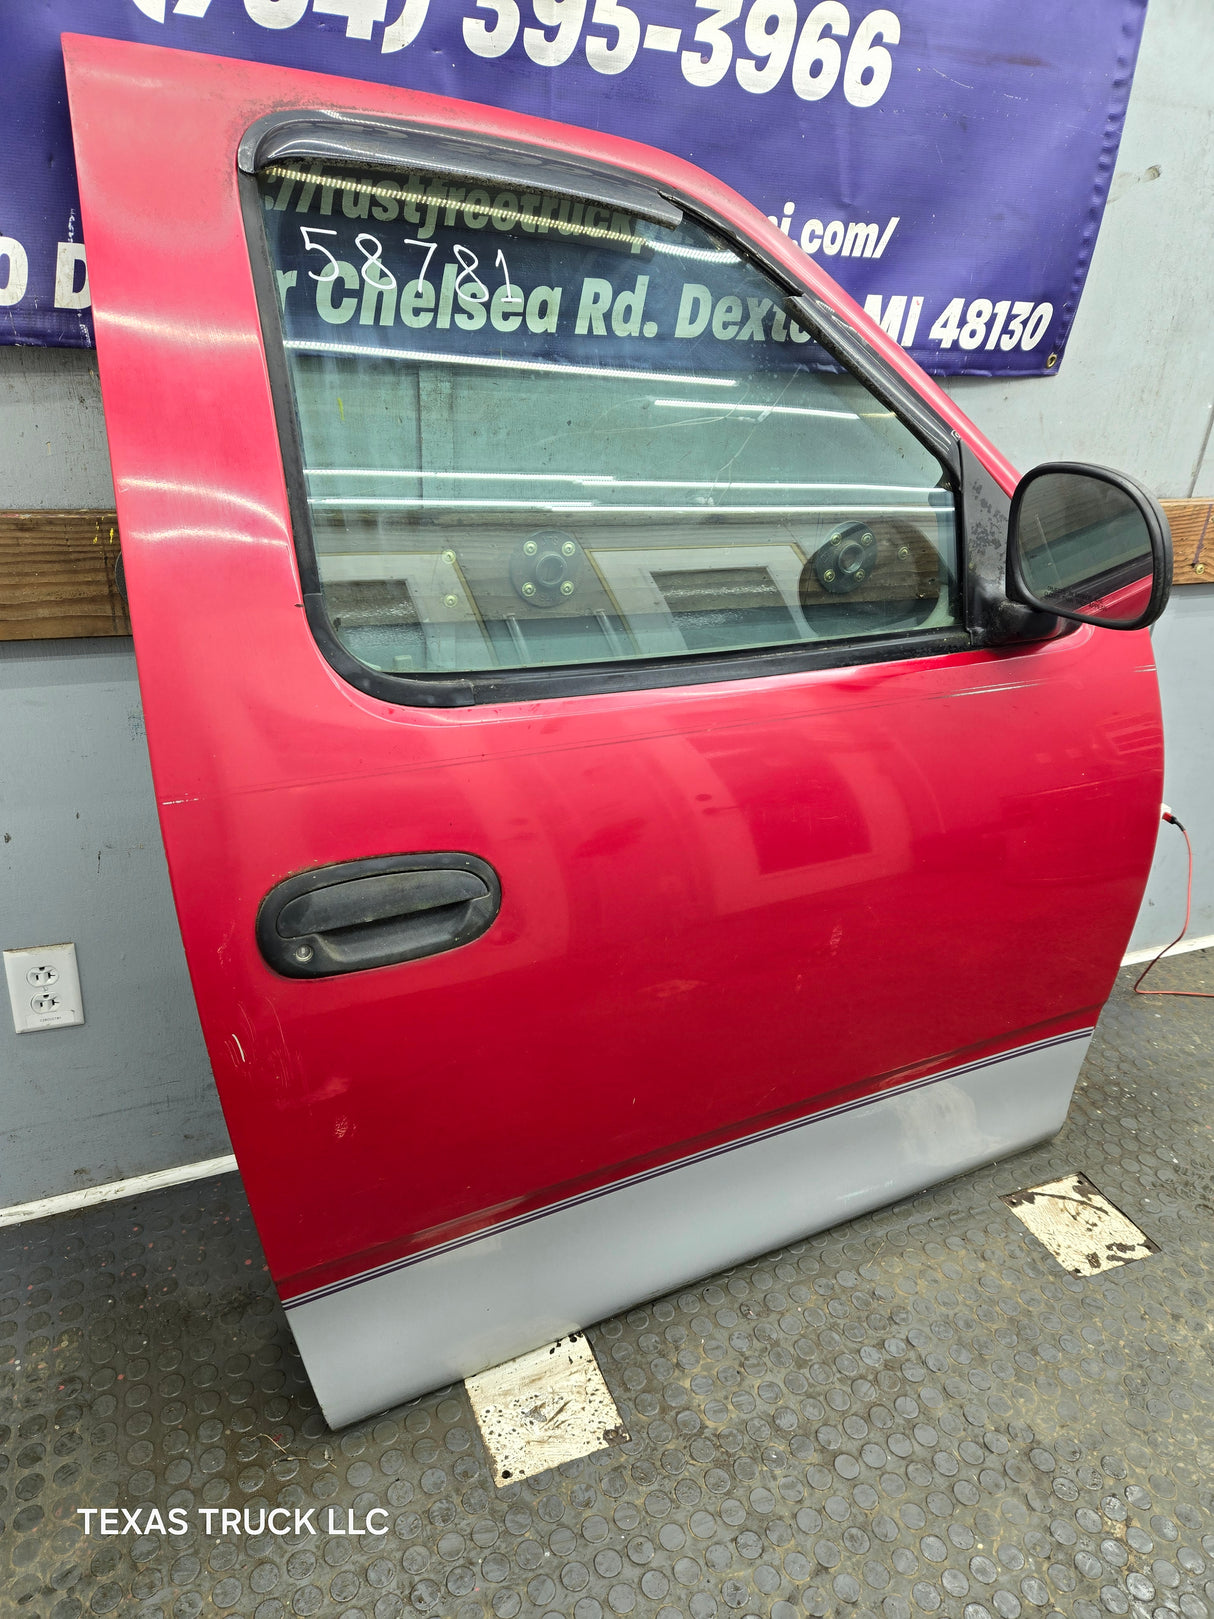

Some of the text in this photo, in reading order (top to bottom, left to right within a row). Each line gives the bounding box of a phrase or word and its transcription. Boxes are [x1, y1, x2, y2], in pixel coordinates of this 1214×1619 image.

[462, 0, 901, 108] 395-3966
[300, 226, 522, 302] 58781
[316, 258, 562, 334] Chelsea
[575, 275, 658, 338] Rd.
[928, 297, 1054, 351] 48130
